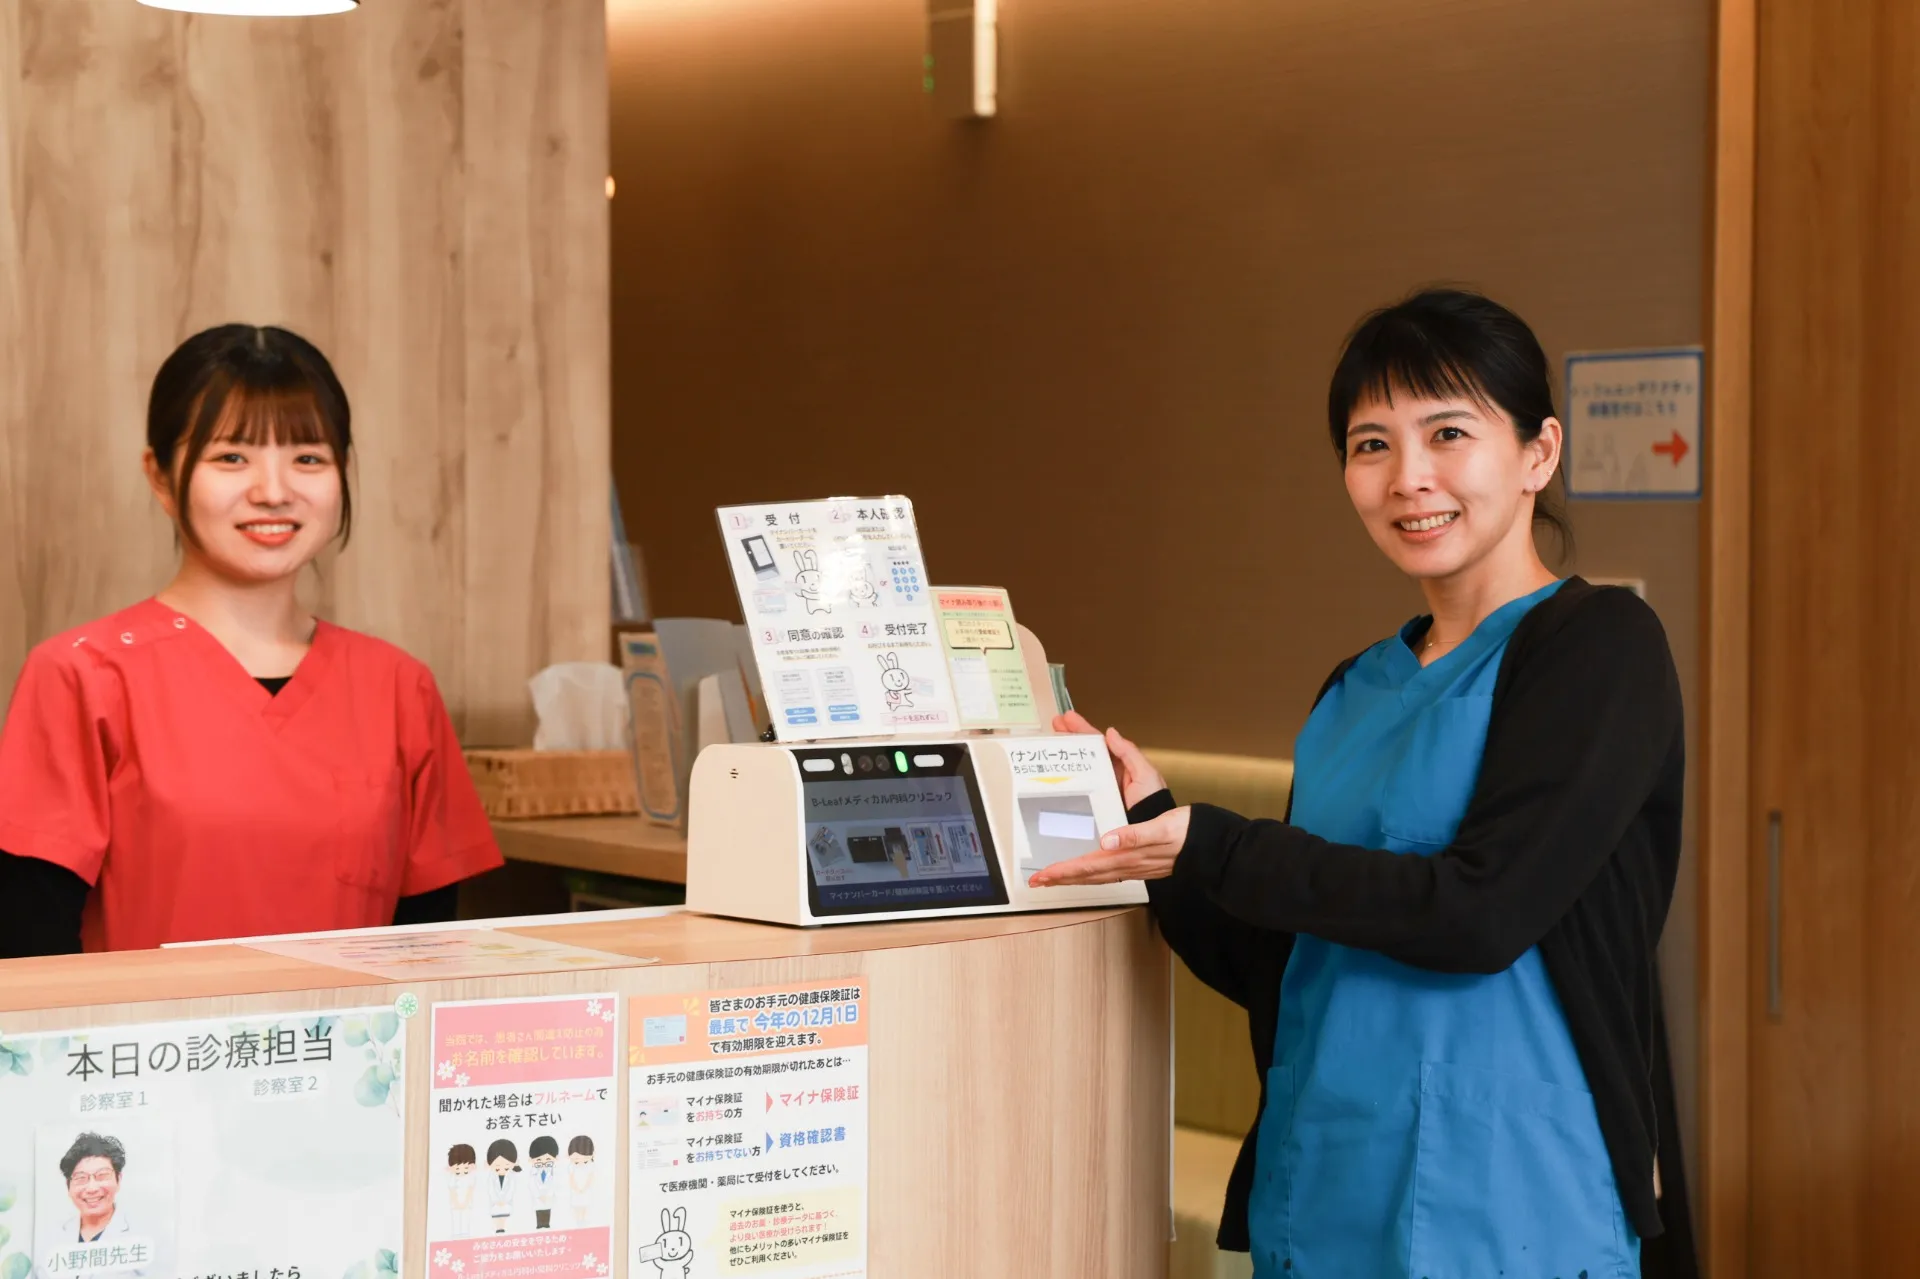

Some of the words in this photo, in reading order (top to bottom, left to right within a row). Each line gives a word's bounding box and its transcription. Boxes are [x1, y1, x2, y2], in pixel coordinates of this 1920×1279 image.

[734, 515, 740, 526] 1
[764, 512, 801, 526] 受付
[831, 509, 839, 520] 2
[765, 631, 773, 642] 3
[787, 626, 845, 642] 同意の確認
[861, 625, 869, 635] 4
[884, 622, 928, 636] 受付完了
[709, 987, 861, 1013] 皆さまのお手元の健康保険証は
[708, 1017, 749, 1036] 最長で
[753, 1004, 858, 1031] 今年の12月1日
[709, 1032, 823, 1054] で有効期限を迎えます。
[66, 1025, 333, 1082] 本日の診療担当
[452, 1044, 605, 1068] お名前を確認しています。
[646, 1056, 851, 1085] お手元の健康保険証の有効期限が切れたあとは…
[438, 1087, 608, 1114] 聞かれた場合はフルネームで
[686, 1092, 743, 1107] マイナ保険証
[779, 1085, 860, 1107] マイナ保険証
[485, 1112, 563, 1131] お答え下さい
[686, 1107, 743, 1123] をお持ちの方
[686, 1132, 743, 1148] マイナ保険証
[779, 1127, 846, 1149] 資格確認書
[686, 1146, 761, 1163] をお持ちでない方
[659, 1163, 840, 1193] で医療機関・薬局にて受付をしてください。
[729, 1202, 805, 1219] マイナ保険証を使うと、
[729, 1231, 849, 1255] 他にもメリットの多いマイナ保険証を
[48, 1243, 148, 1272] 小野間先生
[729, 1252, 798, 1267] ぜひご利用ください。
